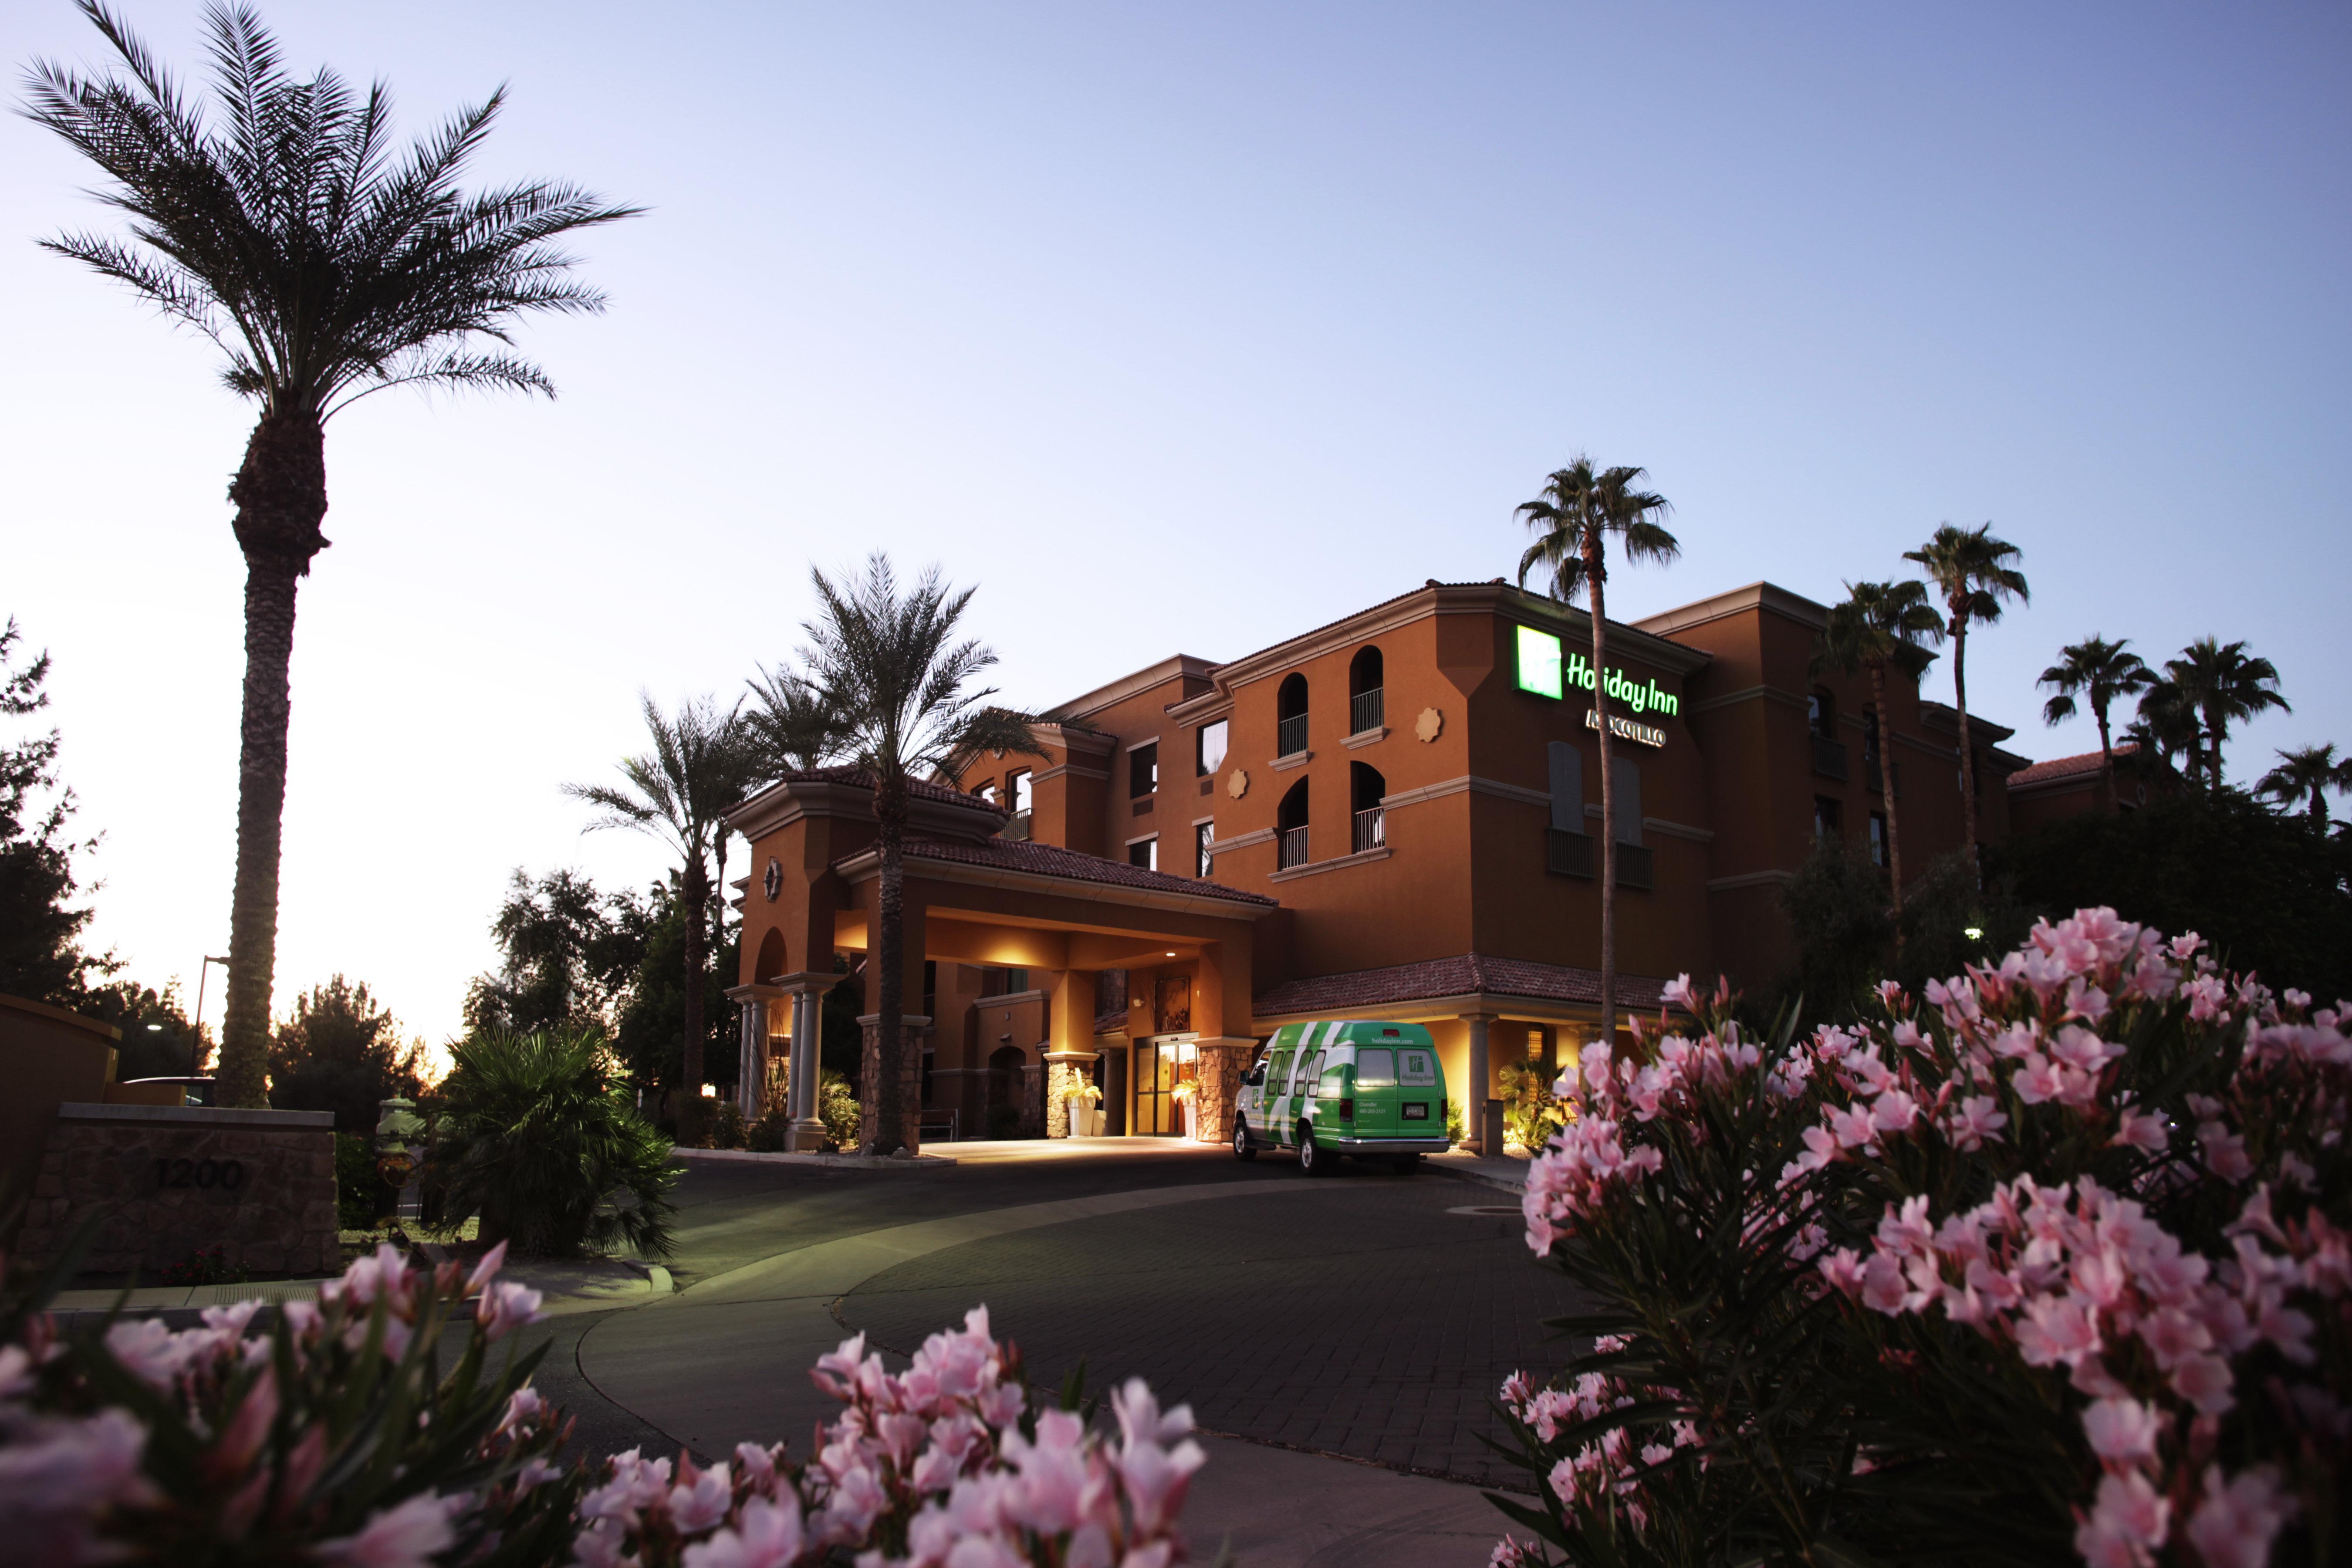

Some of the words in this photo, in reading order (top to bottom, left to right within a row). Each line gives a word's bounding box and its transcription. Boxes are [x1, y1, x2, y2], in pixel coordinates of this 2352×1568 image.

[1567, 653, 1646, 713] Hoiday
[1648, 679, 1677, 716] Inn
[1402, 1074, 1423, 1082] Holiday
[157, 1158, 243, 1190] 1200
